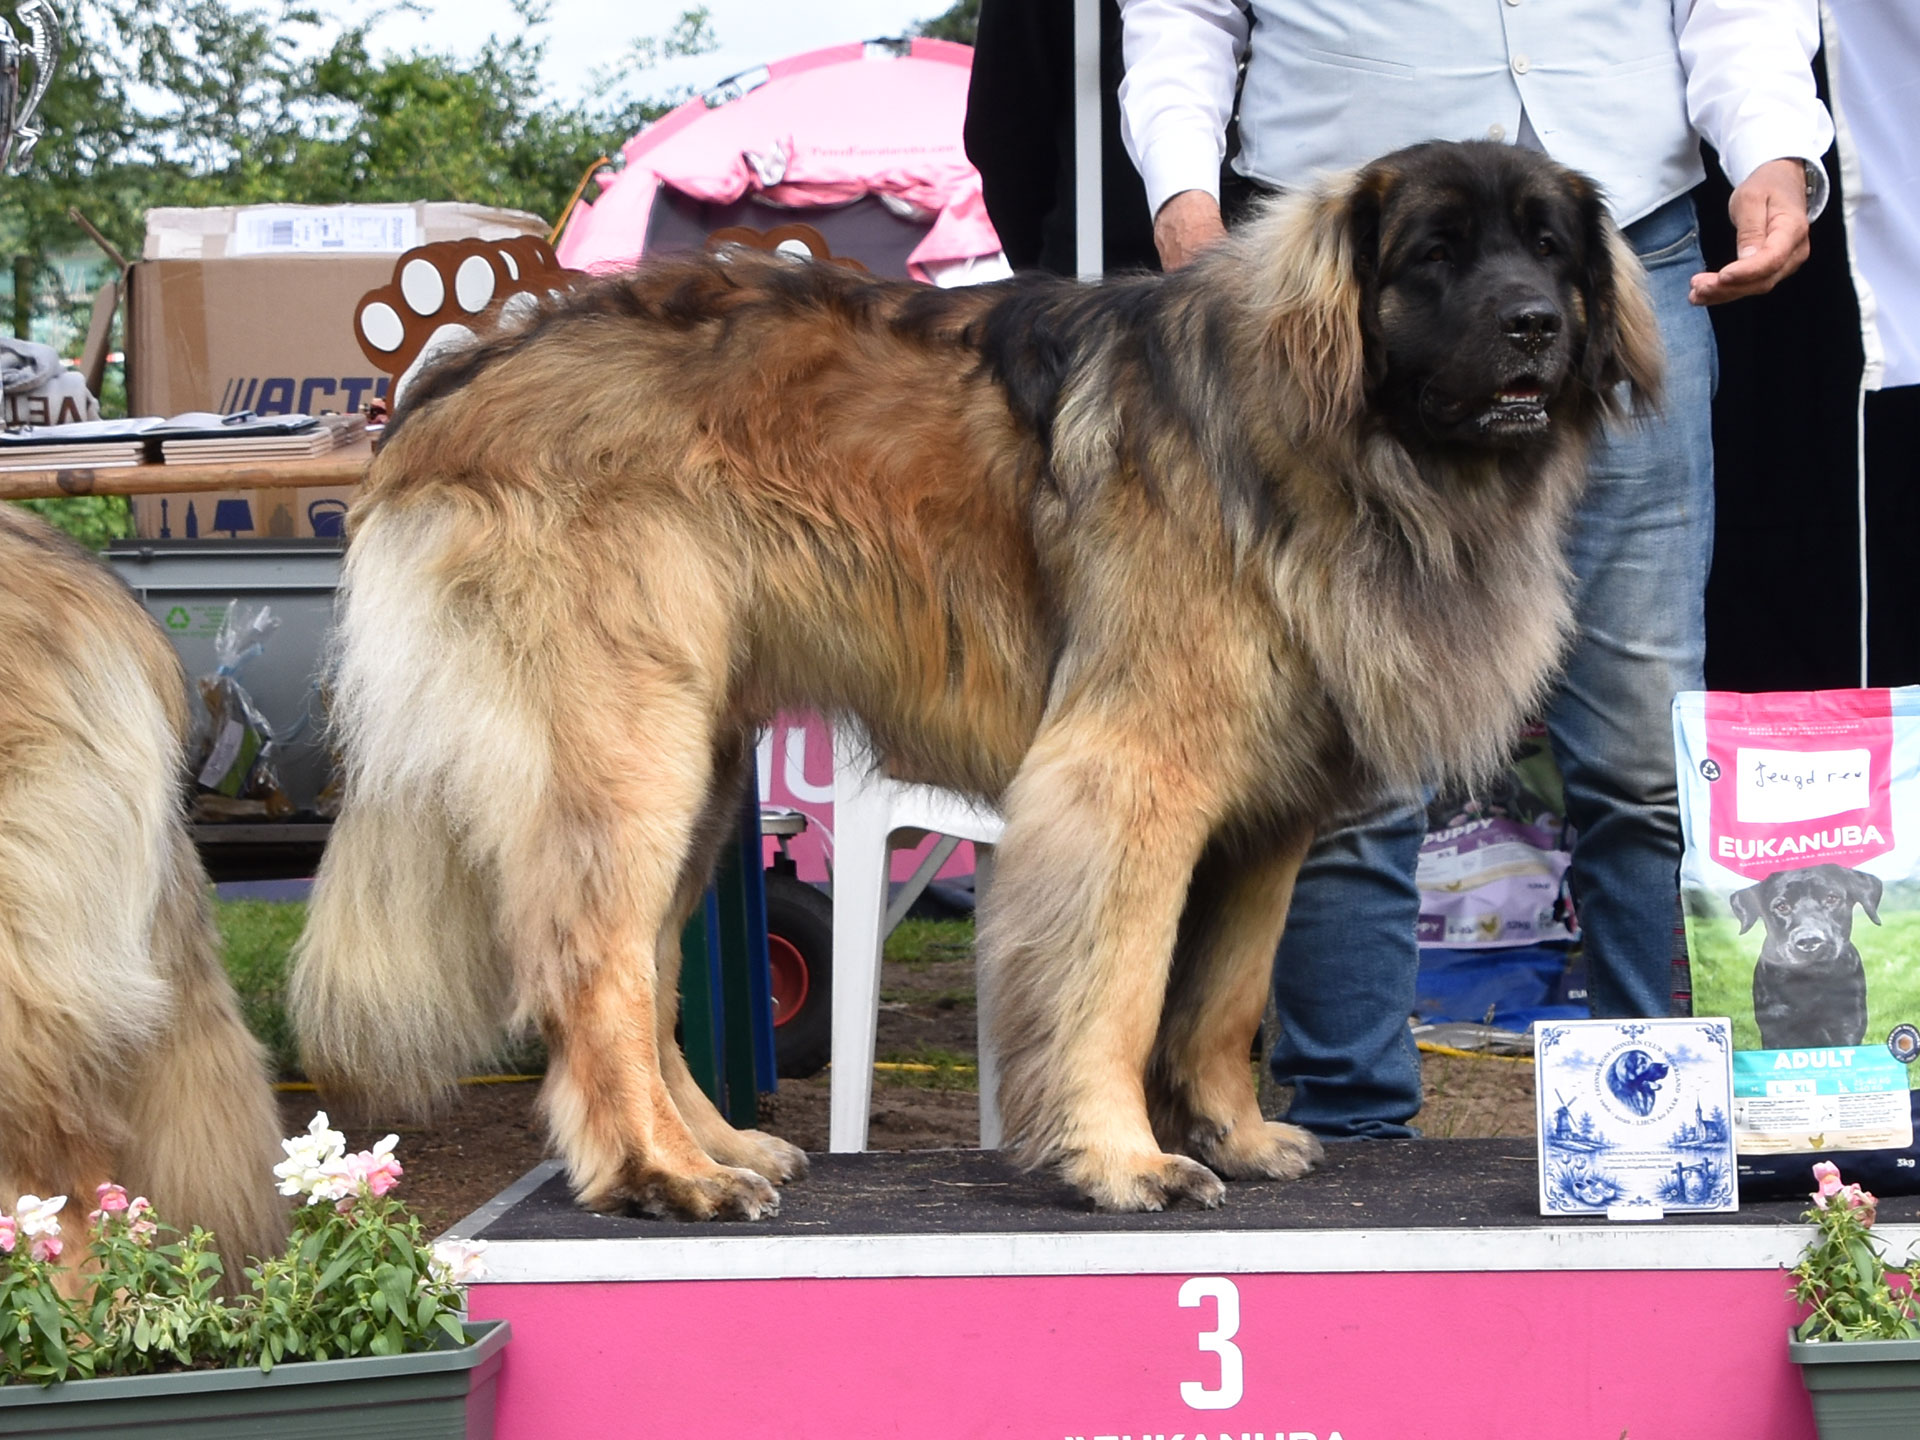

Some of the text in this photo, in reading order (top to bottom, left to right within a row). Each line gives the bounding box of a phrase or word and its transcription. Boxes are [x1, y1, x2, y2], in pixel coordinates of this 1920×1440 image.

[1421, 818, 1494, 846] PUPPY
[1718, 825, 1885, 860] EUKANUBA
[1773, 1049, 1856, 1071] ADULT
[1896, 1158, 1916, 1168] 3kg
[1178, 1277, 1244, 1410] 3
